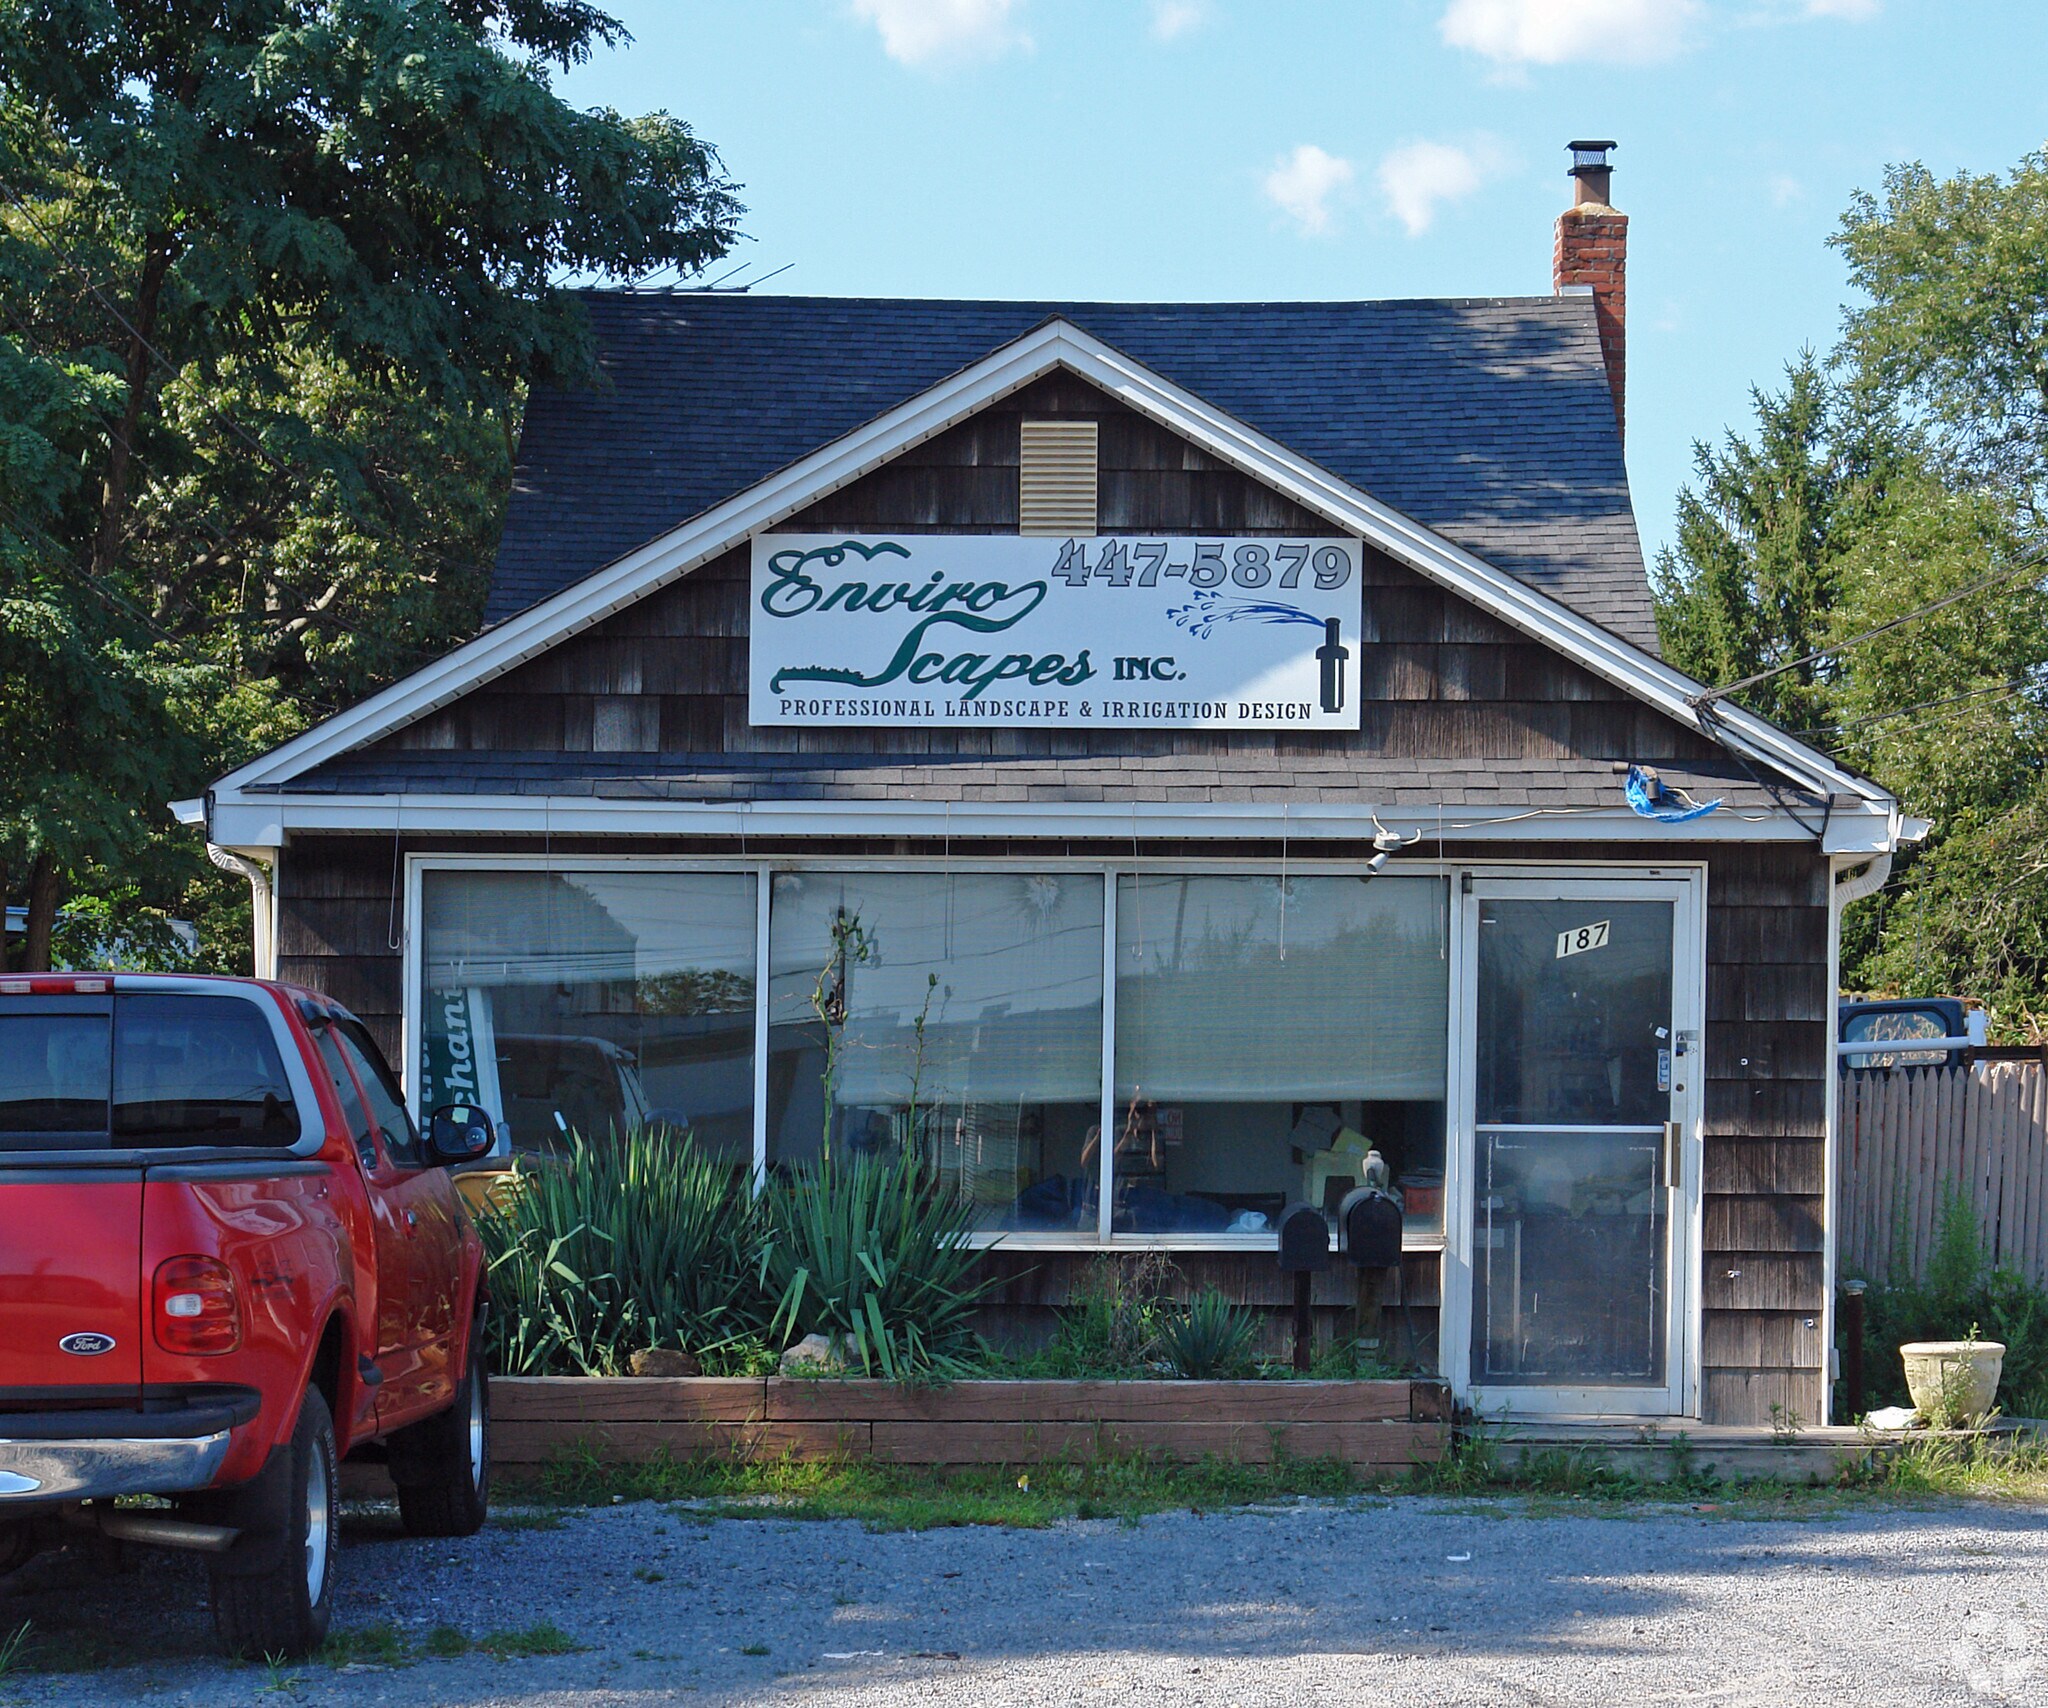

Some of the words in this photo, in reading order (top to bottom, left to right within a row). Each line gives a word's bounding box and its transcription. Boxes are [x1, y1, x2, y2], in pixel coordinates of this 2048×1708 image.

[761, 540, 1047, 620] Enviro
[1051, 539, 1352, 590] 447-5879
[770, 610, 1097, 700] Scapes
[1112, 656, 1187, 681] INC.
[779, 699, 935, 717] PROFESSIONAL
[944, 699, 1069, 717] LANDSCAPE
[1079, 701, 1093, 717] &
[1102, 701, 1228, 719] IRRIGATION
[1238, 703, 1312, 720] DESIGN
[1563, 922, 1608, 955] 187
[72, 1337, 102, 1351] Ford
